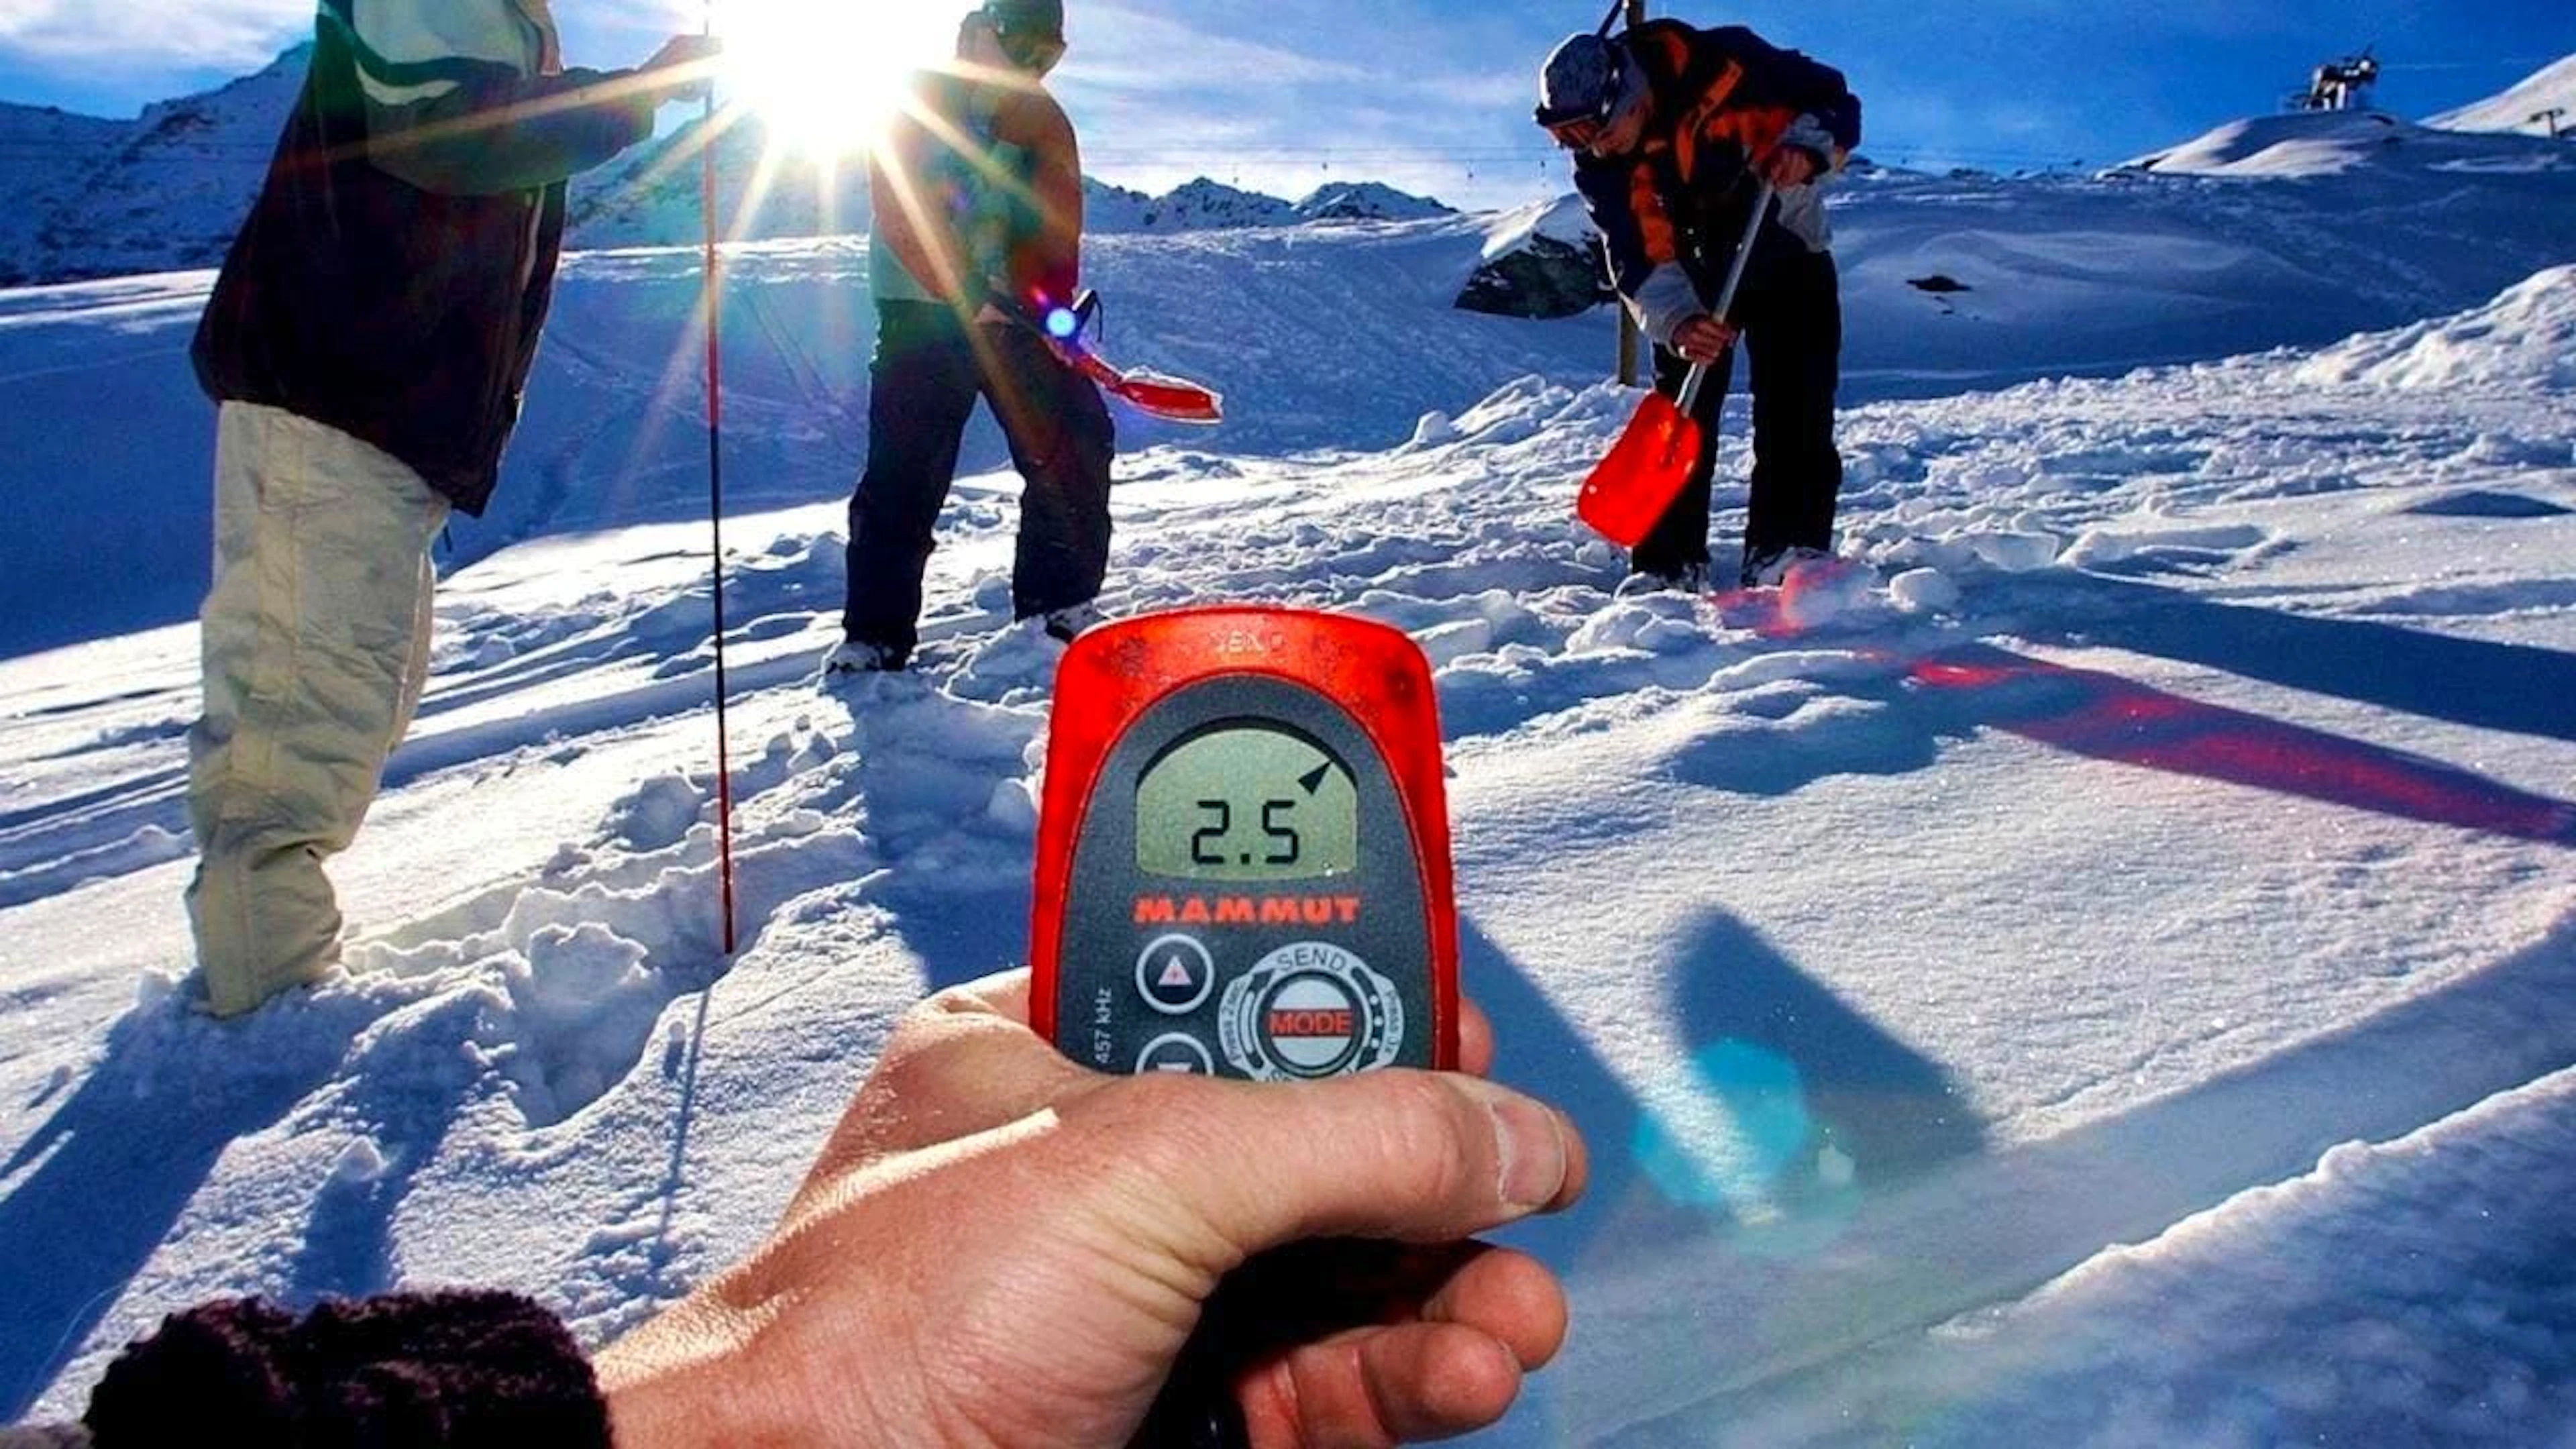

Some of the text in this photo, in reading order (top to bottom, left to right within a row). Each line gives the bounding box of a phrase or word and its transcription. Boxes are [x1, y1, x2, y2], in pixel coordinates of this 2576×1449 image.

[1191, 800, 1299, 865] 2.5
[1133, 896, 1360, 922] MAMMUT
[1277, 947, 1347, 971] SEND
[1094, 988, 1112, 1063] 457 kHz
[1269, 1011, 1352, 1034] MODE
